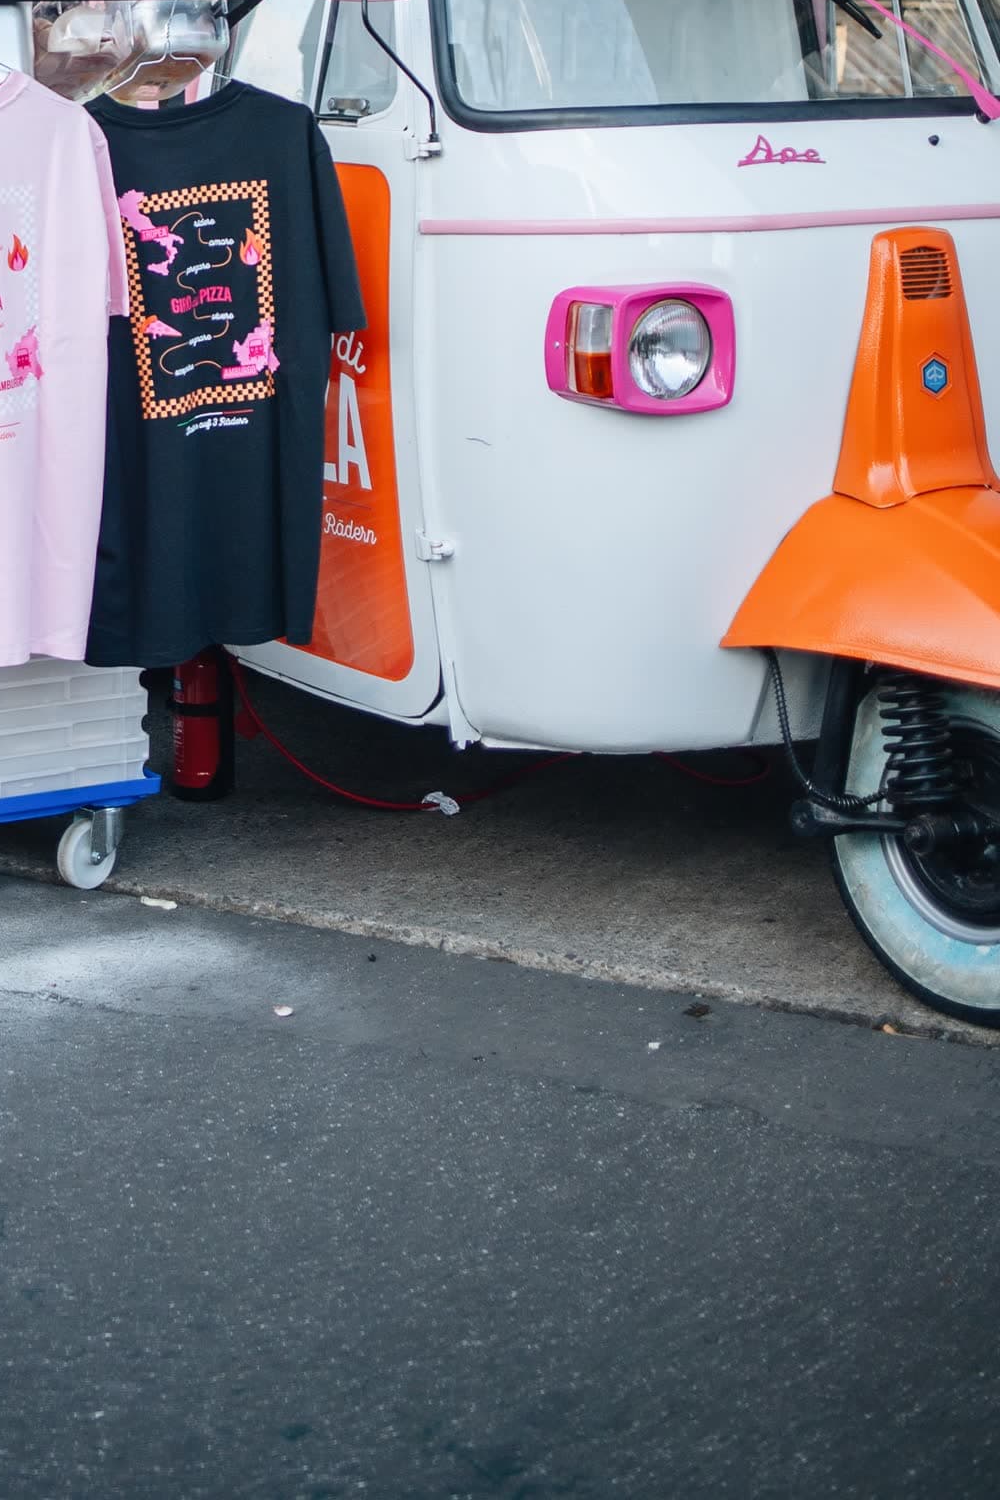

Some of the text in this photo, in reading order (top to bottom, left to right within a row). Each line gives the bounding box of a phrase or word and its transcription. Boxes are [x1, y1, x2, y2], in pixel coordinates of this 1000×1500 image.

[739, 134, 824, 167] Ape
[199, 286, 233, 304] PIZZA
[212, 417, 218, 427] 3
[323, 512, 377, 545] Rädern
